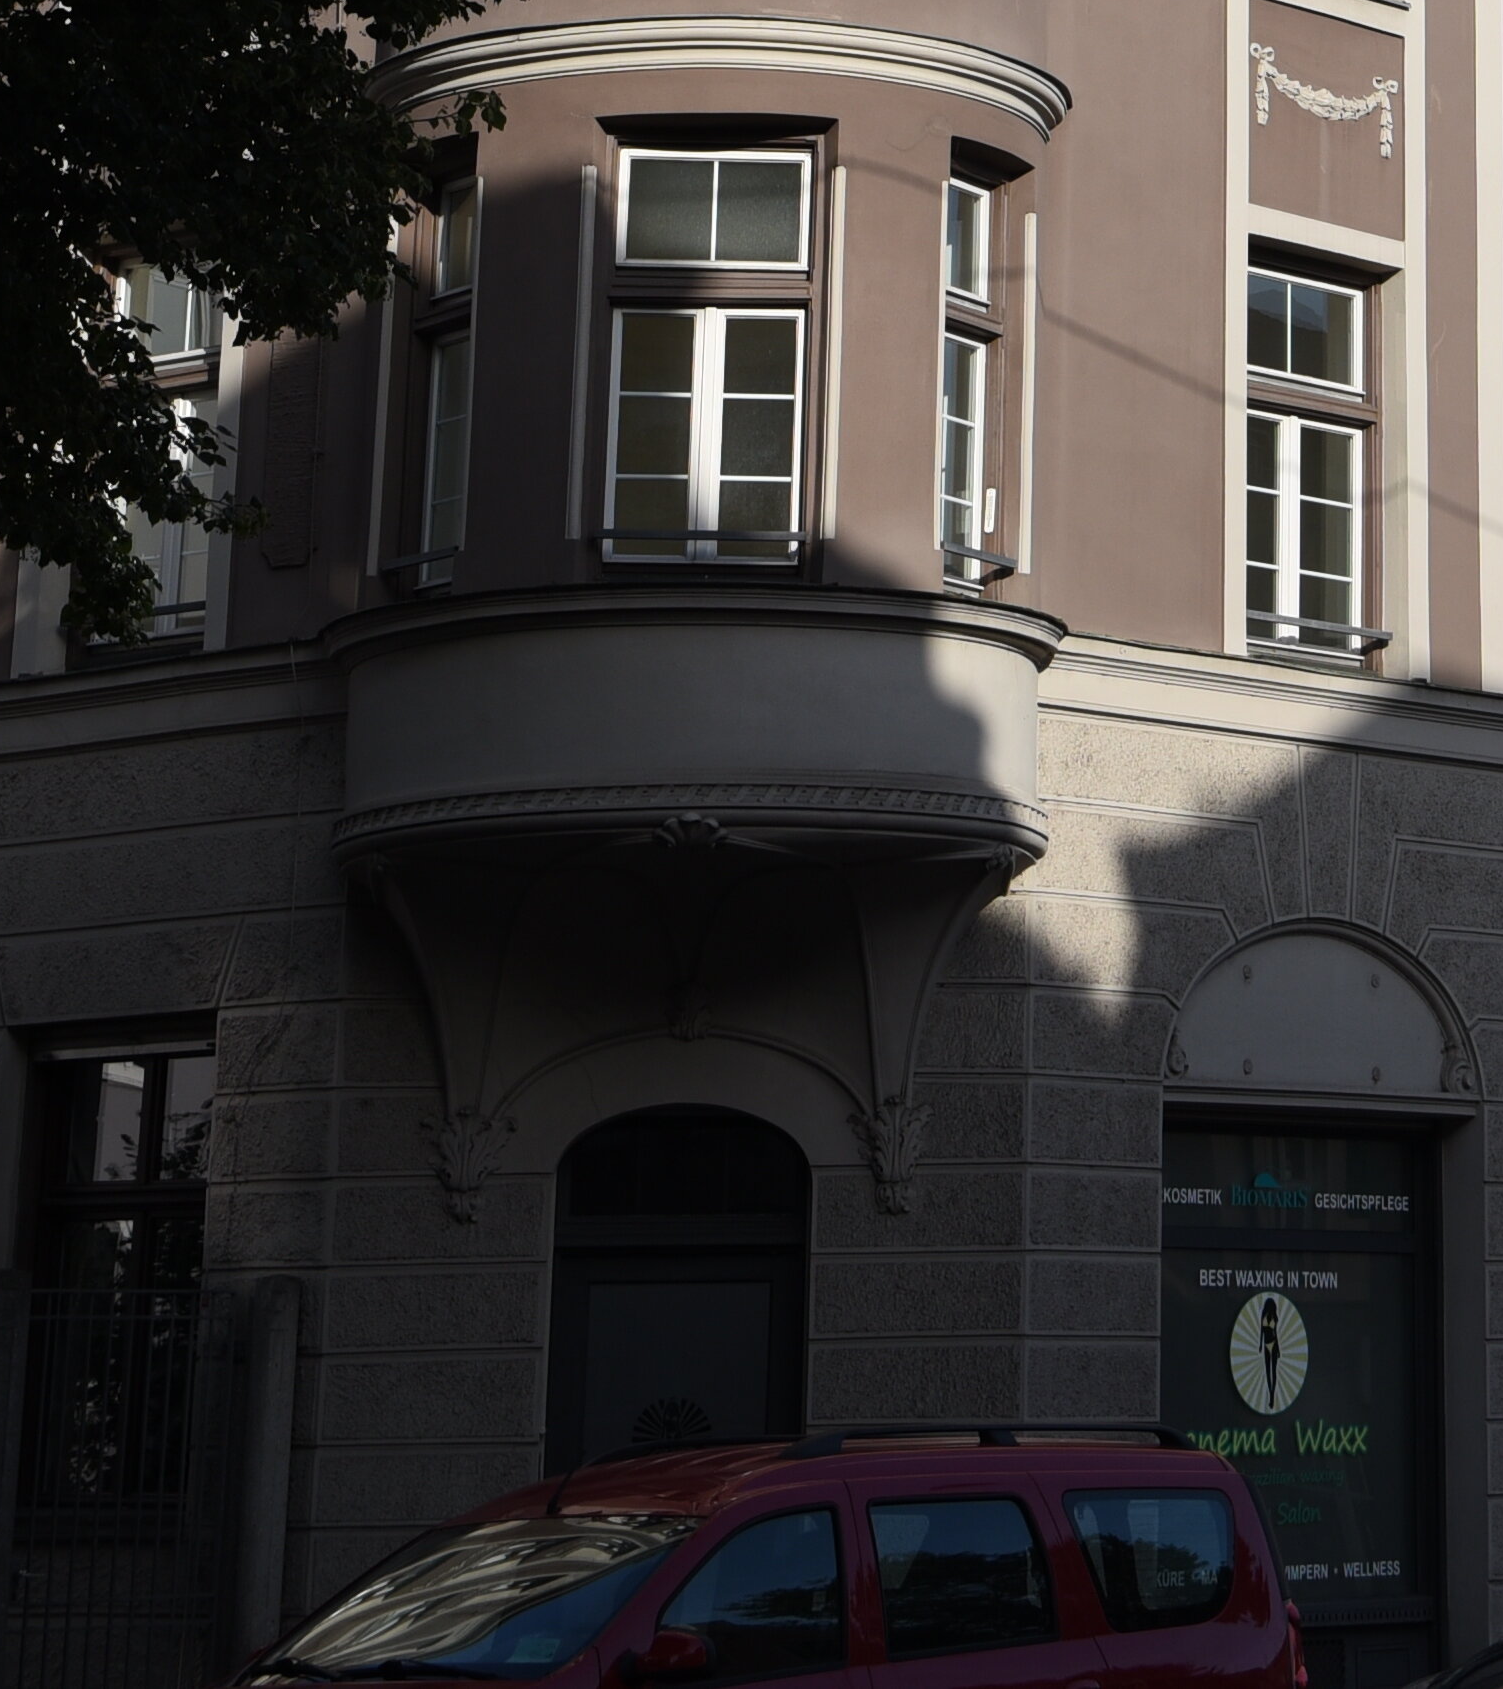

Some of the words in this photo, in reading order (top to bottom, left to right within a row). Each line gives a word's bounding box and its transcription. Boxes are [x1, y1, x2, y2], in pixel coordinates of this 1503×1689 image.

[1163, 1187, 1222, 1205] KOSMETIK
[1314, 1192, 1409, 1211] GESICHTSPFLEGE
[1199, 1268, 1232, 1287] BEST
[1235, 1270, 1283, 1288] WAXING
[1287, 1271, 1298, 1288] IN
[1302, 1272, 1337, 1289] TOWN
[1294, 1418, 1367, 1456] Waxx
[1276, 1498, 1322, 1526] Salon
[1342, 1560, 1400, 1578] WELLNESS
